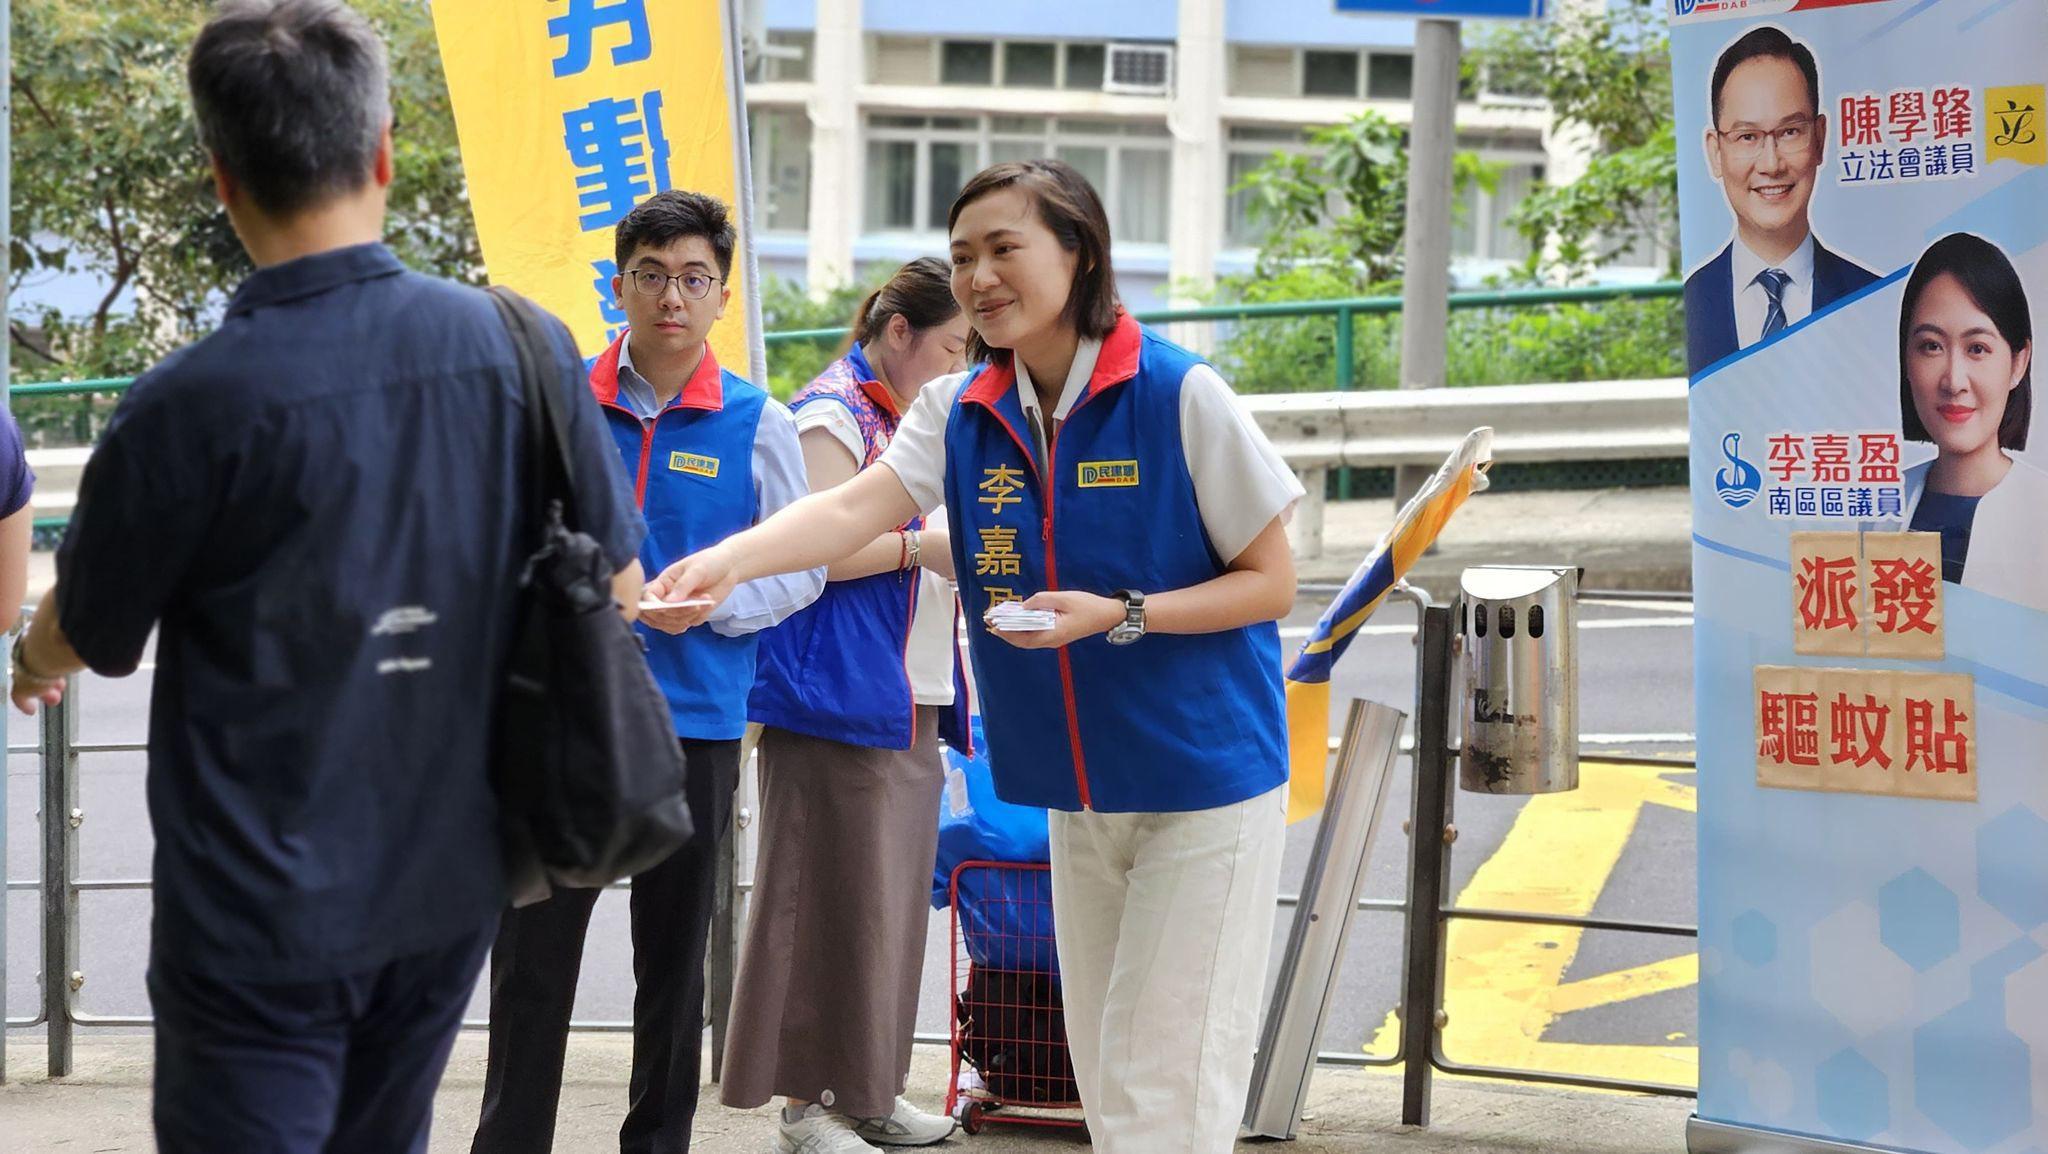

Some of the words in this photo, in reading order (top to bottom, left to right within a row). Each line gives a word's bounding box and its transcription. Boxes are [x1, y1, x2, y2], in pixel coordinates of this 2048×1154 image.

[1840, 88, 1973, 146] 陳學鋒
[1841, 143, 1975, 182] 立法會議員
[1768, 434, 1901, 483] 李嘉盈
[1768, 487, 1902, 517] 南區區議員
[1796, 556, 1937, 635] 派發
[1759, 690, 1969, 775] 驅蚊貼
